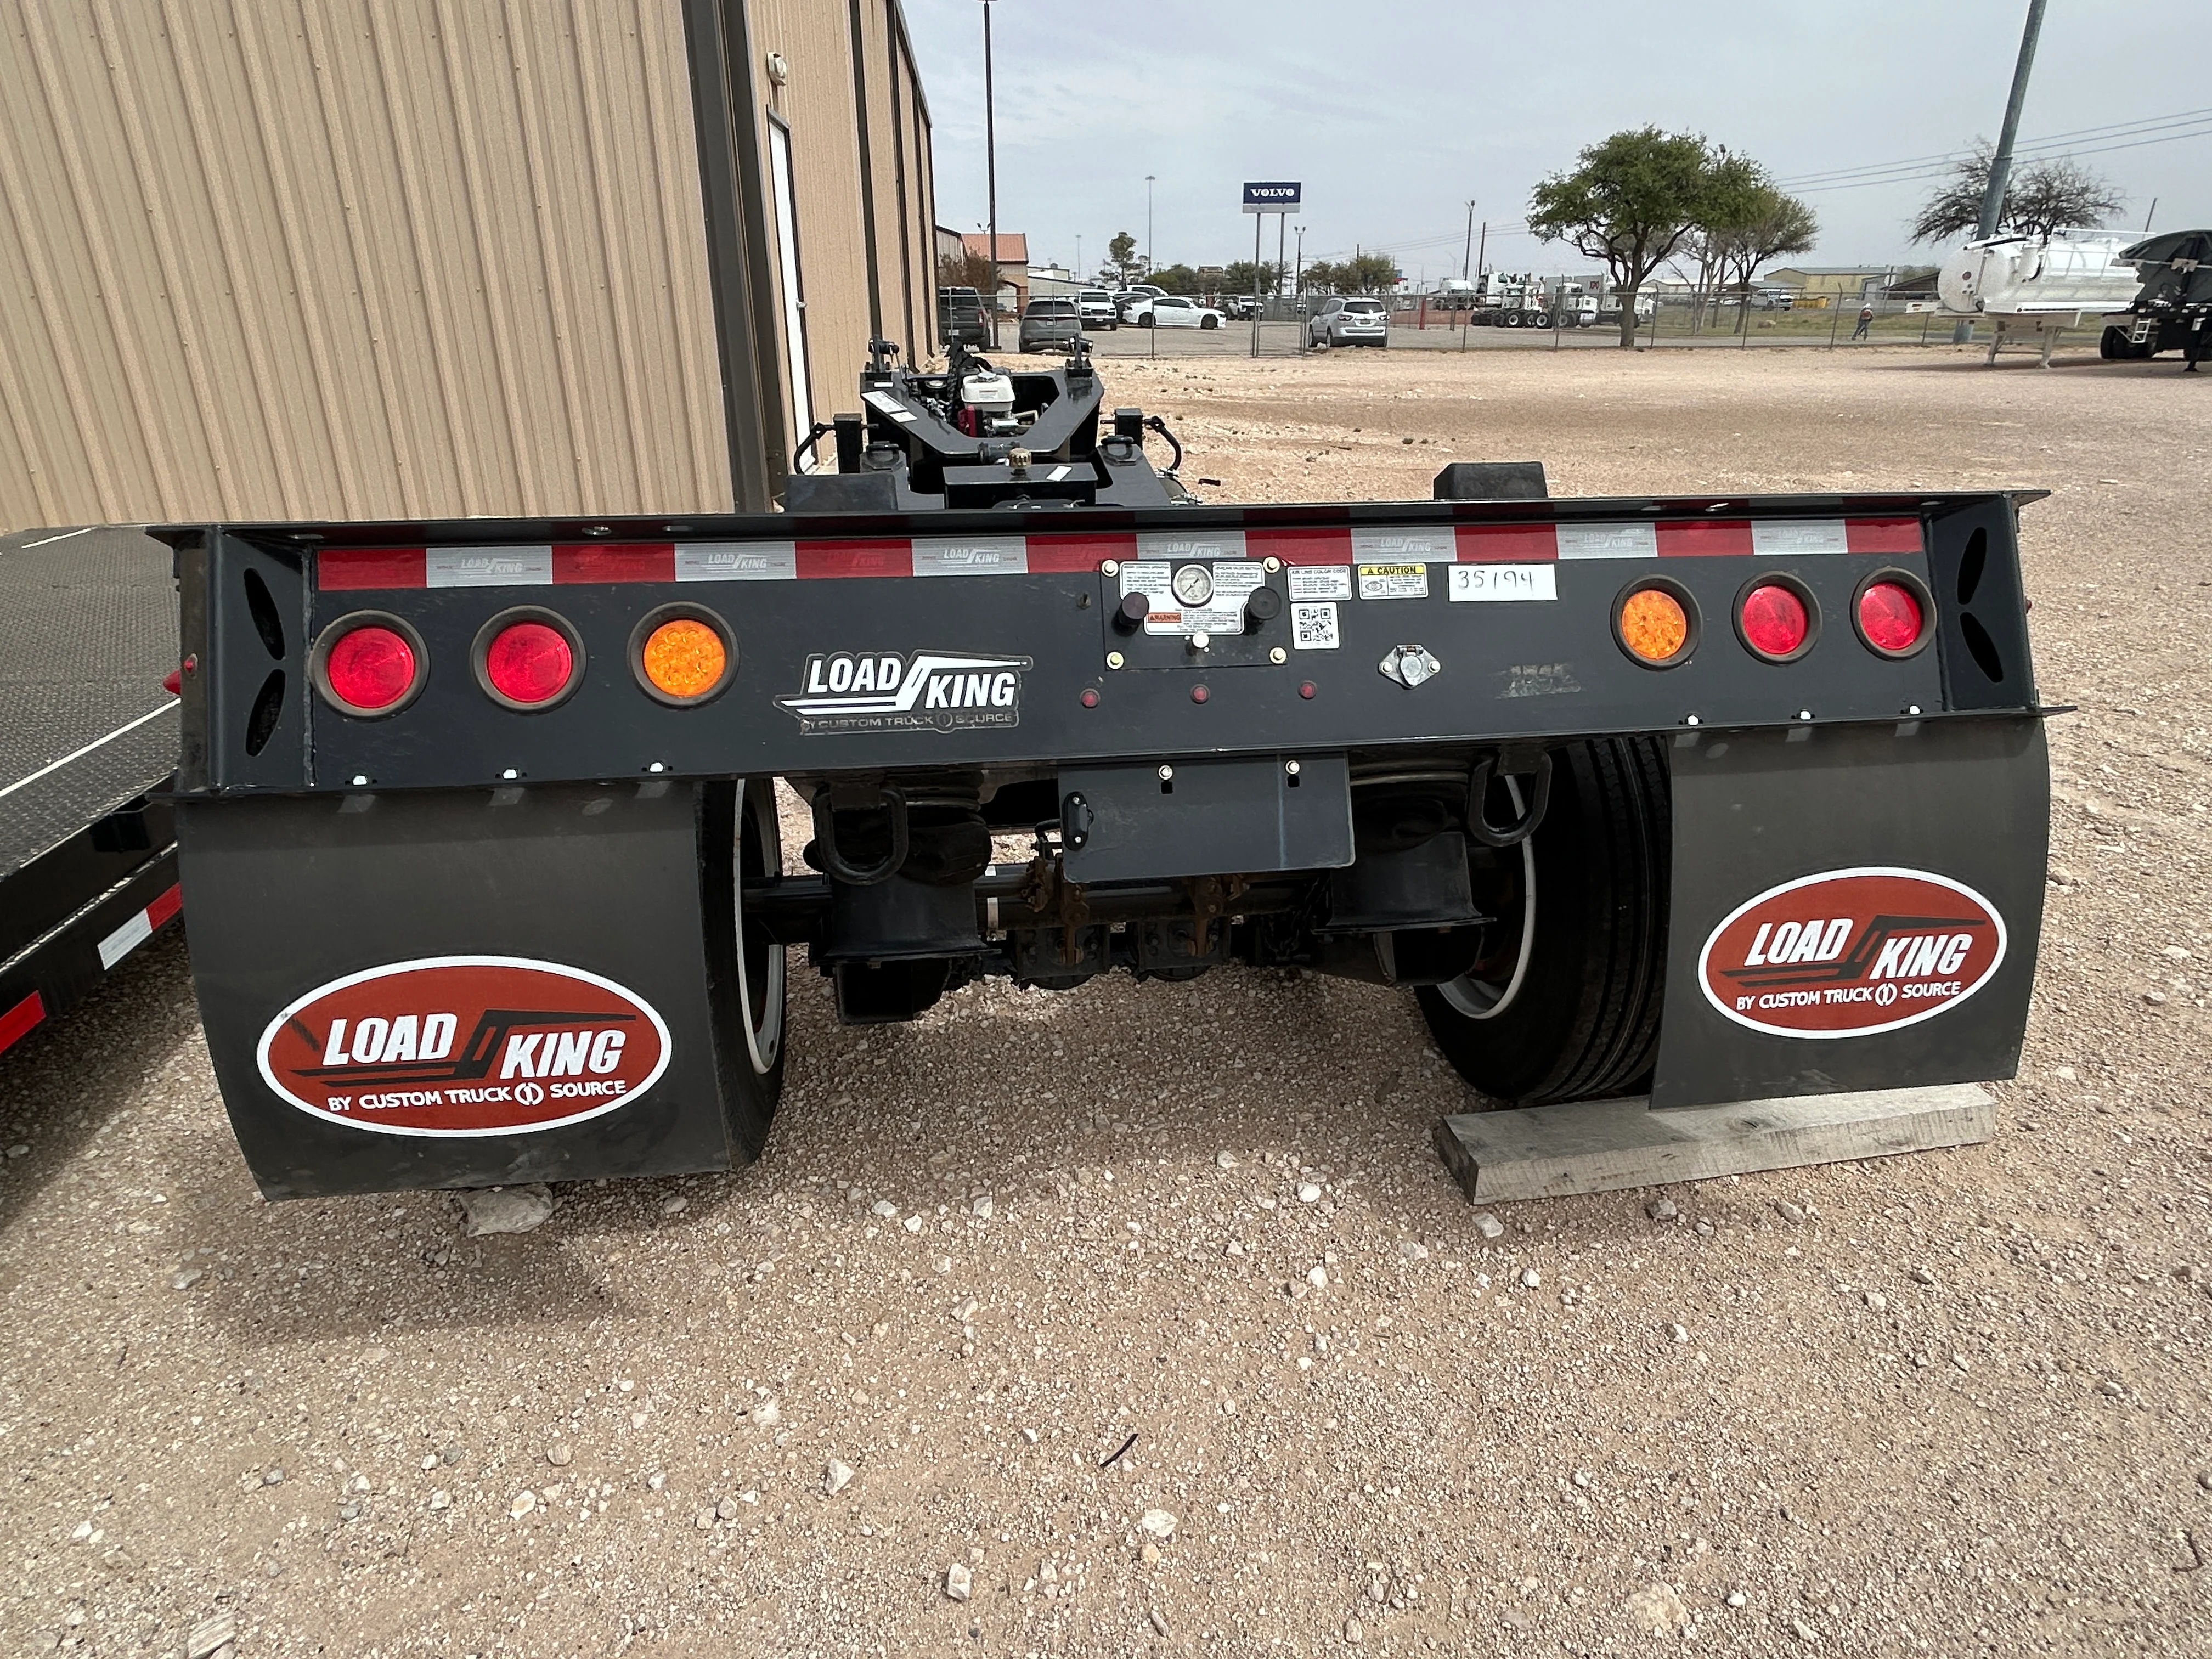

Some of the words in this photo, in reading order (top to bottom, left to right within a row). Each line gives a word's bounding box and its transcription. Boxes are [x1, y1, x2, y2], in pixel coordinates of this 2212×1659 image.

[1250, 188, 1295, 196] VOLVO
[1167, 543, 1191, 553] LOAD
[1195, 548, 1221, 557] KING
[1380, 538, 1403, 547] LOAD
[1408, 543, 1431, 552] KING
[708, 554, 736, 564] LOAD
[740, 558, 767, 569] KING
[943, 549, 969, 558] LOAD
[974, 553, 1000, 563] KING
[1377, 566, 1416, 575] CAUTION
[1458, 570, 1534, 592] 35194
[808, 657, 902, 693] LOAD
[925, 673, 1017, 709] KING
[818, 718, 882, 729] CUSTOM
[885, 716, 934, 726] TRUCK
[1744, 918, 1853, 967] LOAD
[1869, 934, 1973, 980] KING
[1736, 995, 1756, 1011] BY
[1759, 991, 1821, 1008] CUSTOM
[1824, 986, 1874, 1005] TRUCK
[1901, 981, 1961, 998] SOURCE
[323, 1013, 458, 1065] LOAD
[499, 1029, 626, 1080] KING
[328, 1096, 352, 1111] BY
[359, 1090, 443, 1109] CUSTOM
[444, 1086, 512, 1104] TRUCK
[550, 1080, 627, 1098] SOURCE
